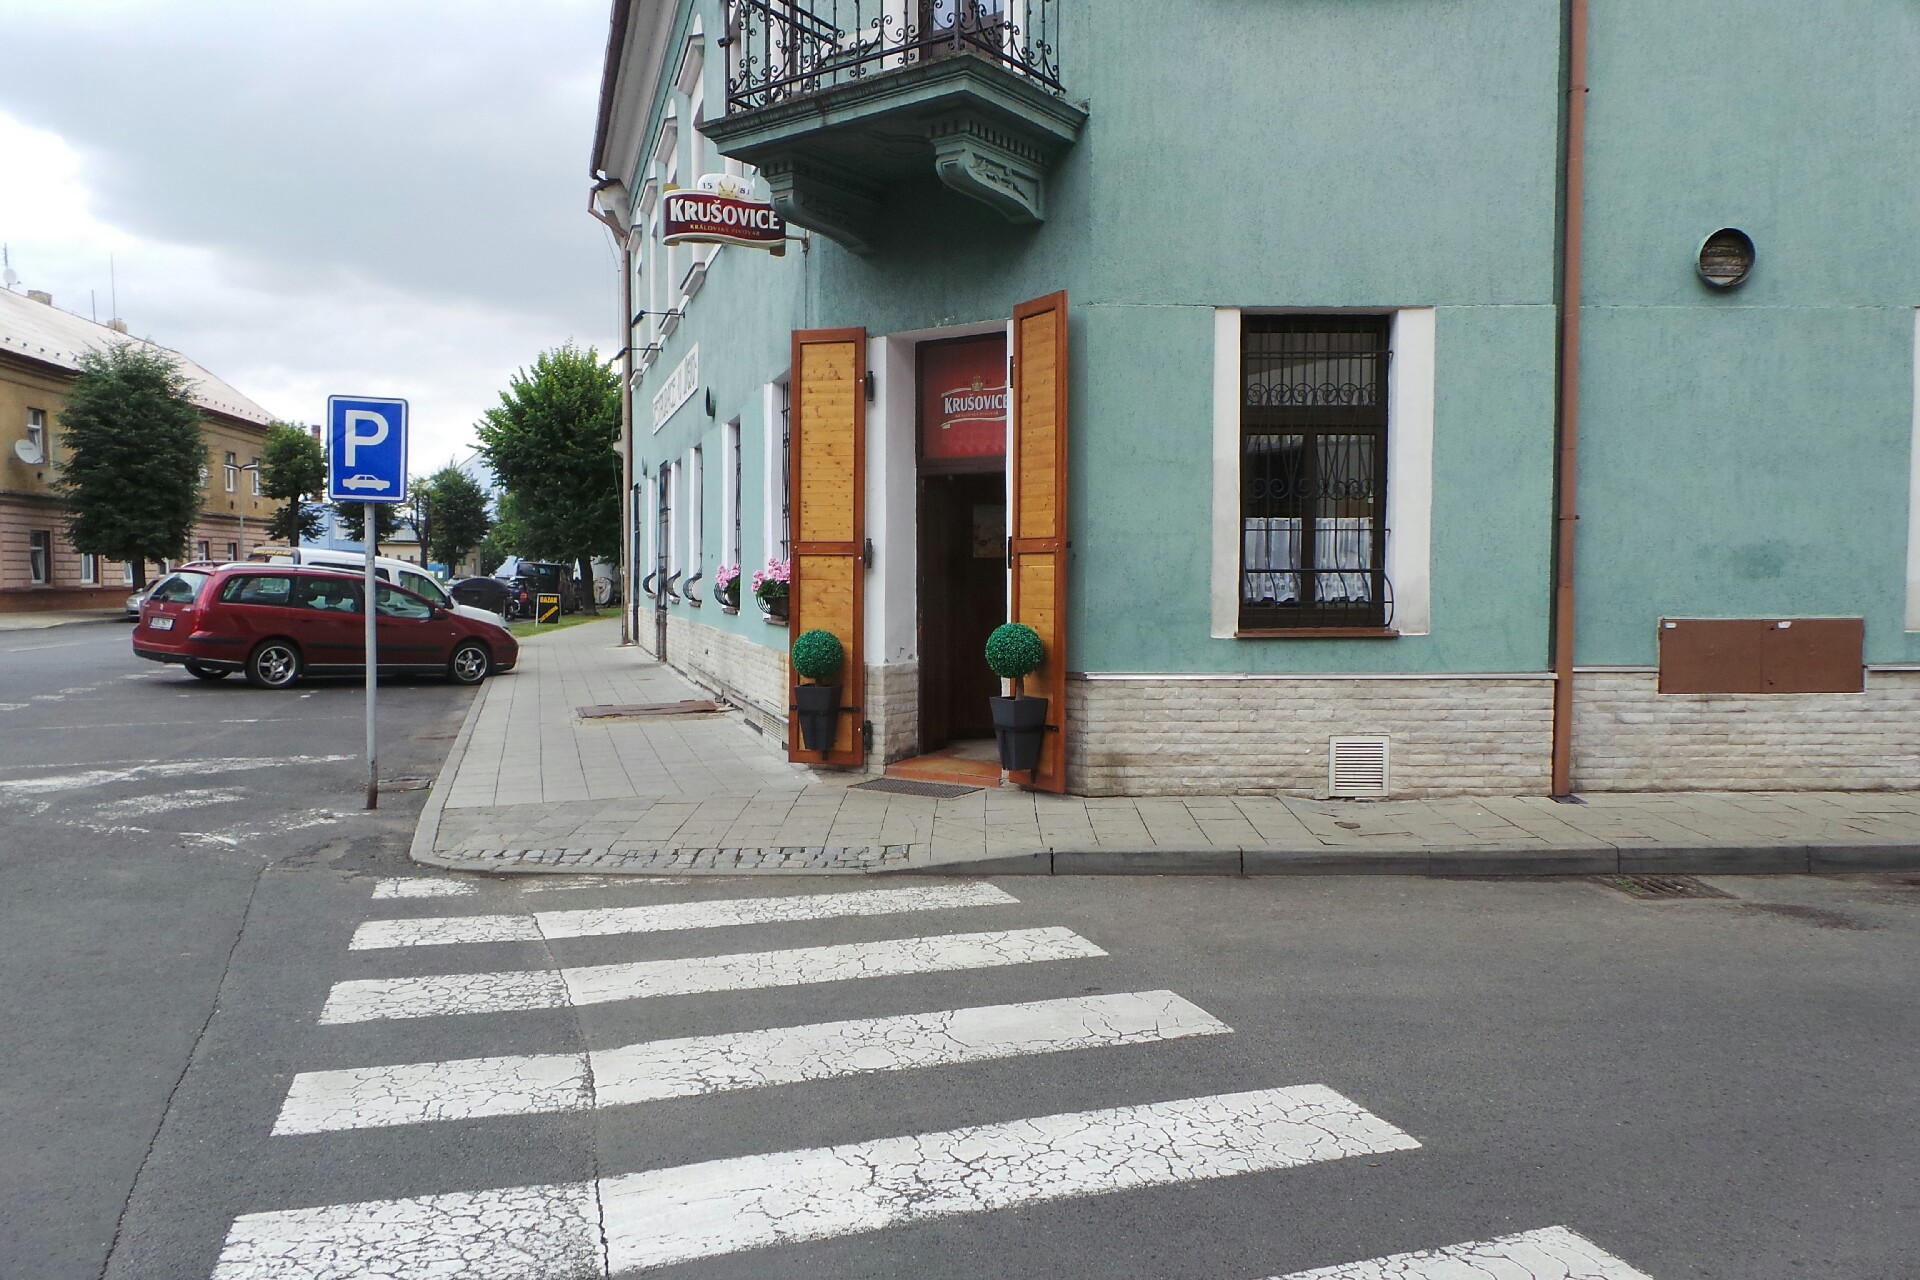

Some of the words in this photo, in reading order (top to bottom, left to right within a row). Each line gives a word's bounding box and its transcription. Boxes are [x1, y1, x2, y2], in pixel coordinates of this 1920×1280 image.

[702, 182, 713, 190] 15
[739, 187, 750, 195] 81
[670, 198, 780, 230] KRUŠOVICE
[344, 409, 389, 467] P
